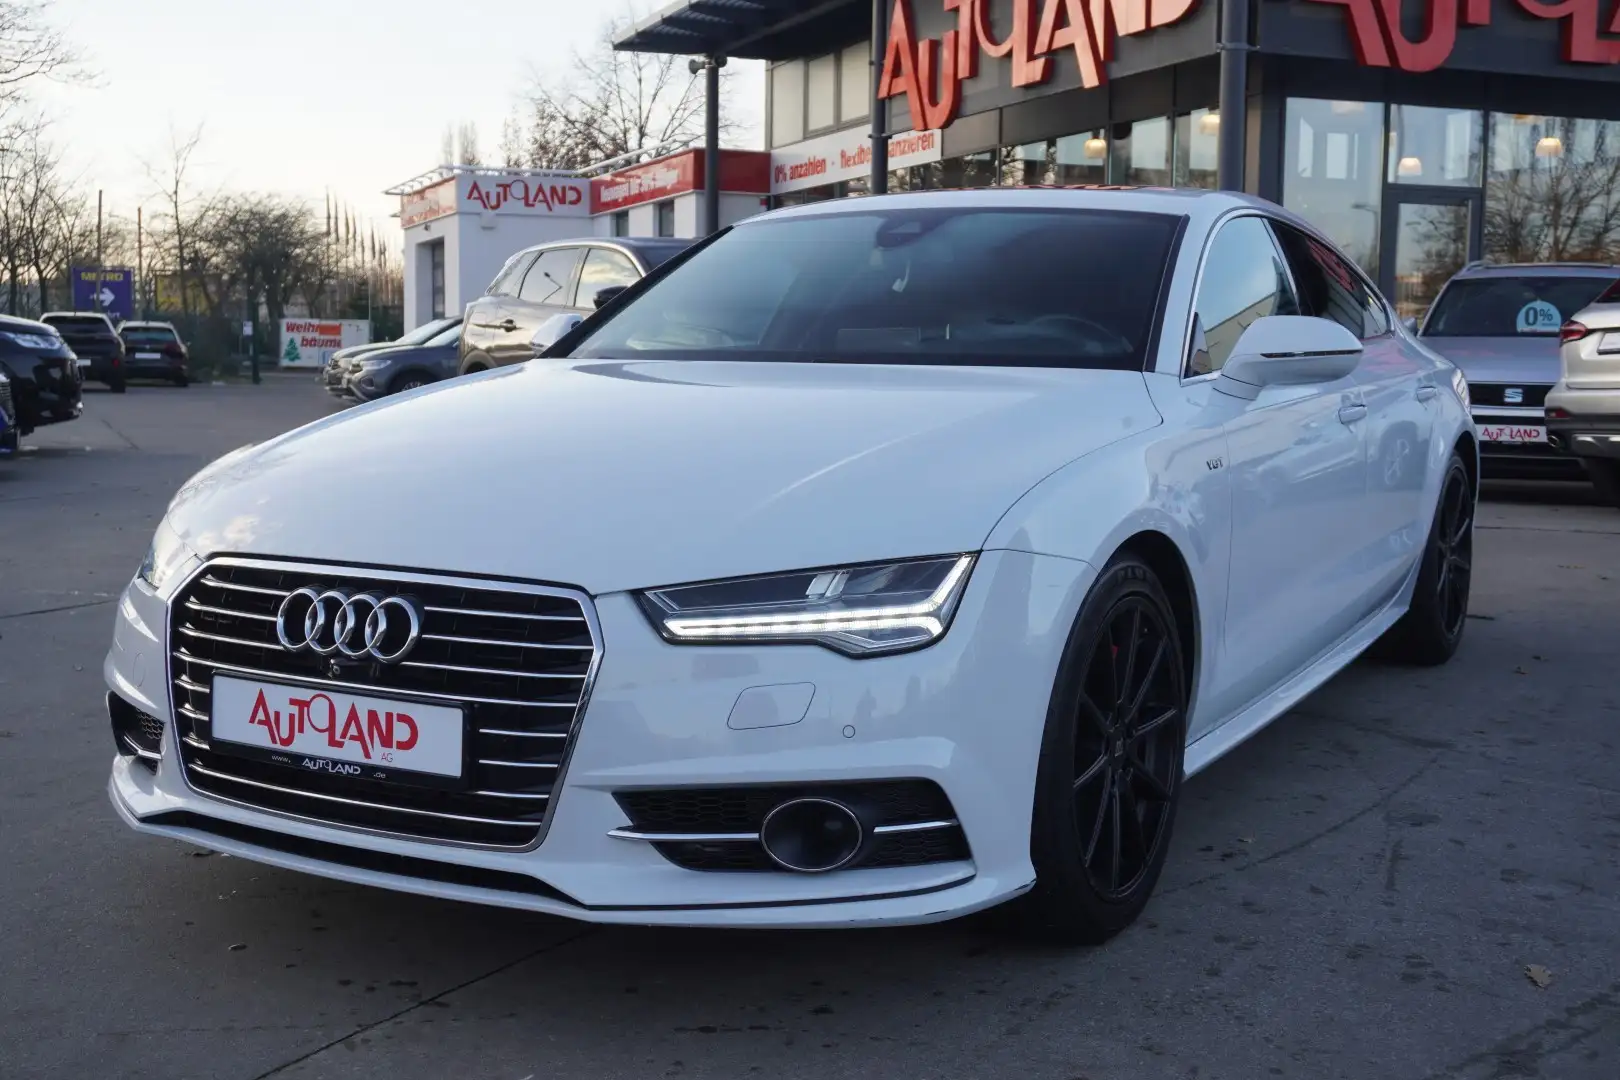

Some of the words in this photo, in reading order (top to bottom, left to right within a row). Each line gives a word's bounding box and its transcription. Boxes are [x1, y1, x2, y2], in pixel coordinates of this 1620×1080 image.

[789, 156, 827, 180] anzahlen
[466, 178, 582, 212] AUTOLAND
[1524, 306, 1554, 326] 0%
[1482, 427, 1541, 440] AUTOLAND
[248, 687, 419, 760] AUTOLAND
[302, 758, 361, 775] AUTOLAND
[381, 752, 394, 763] AG
